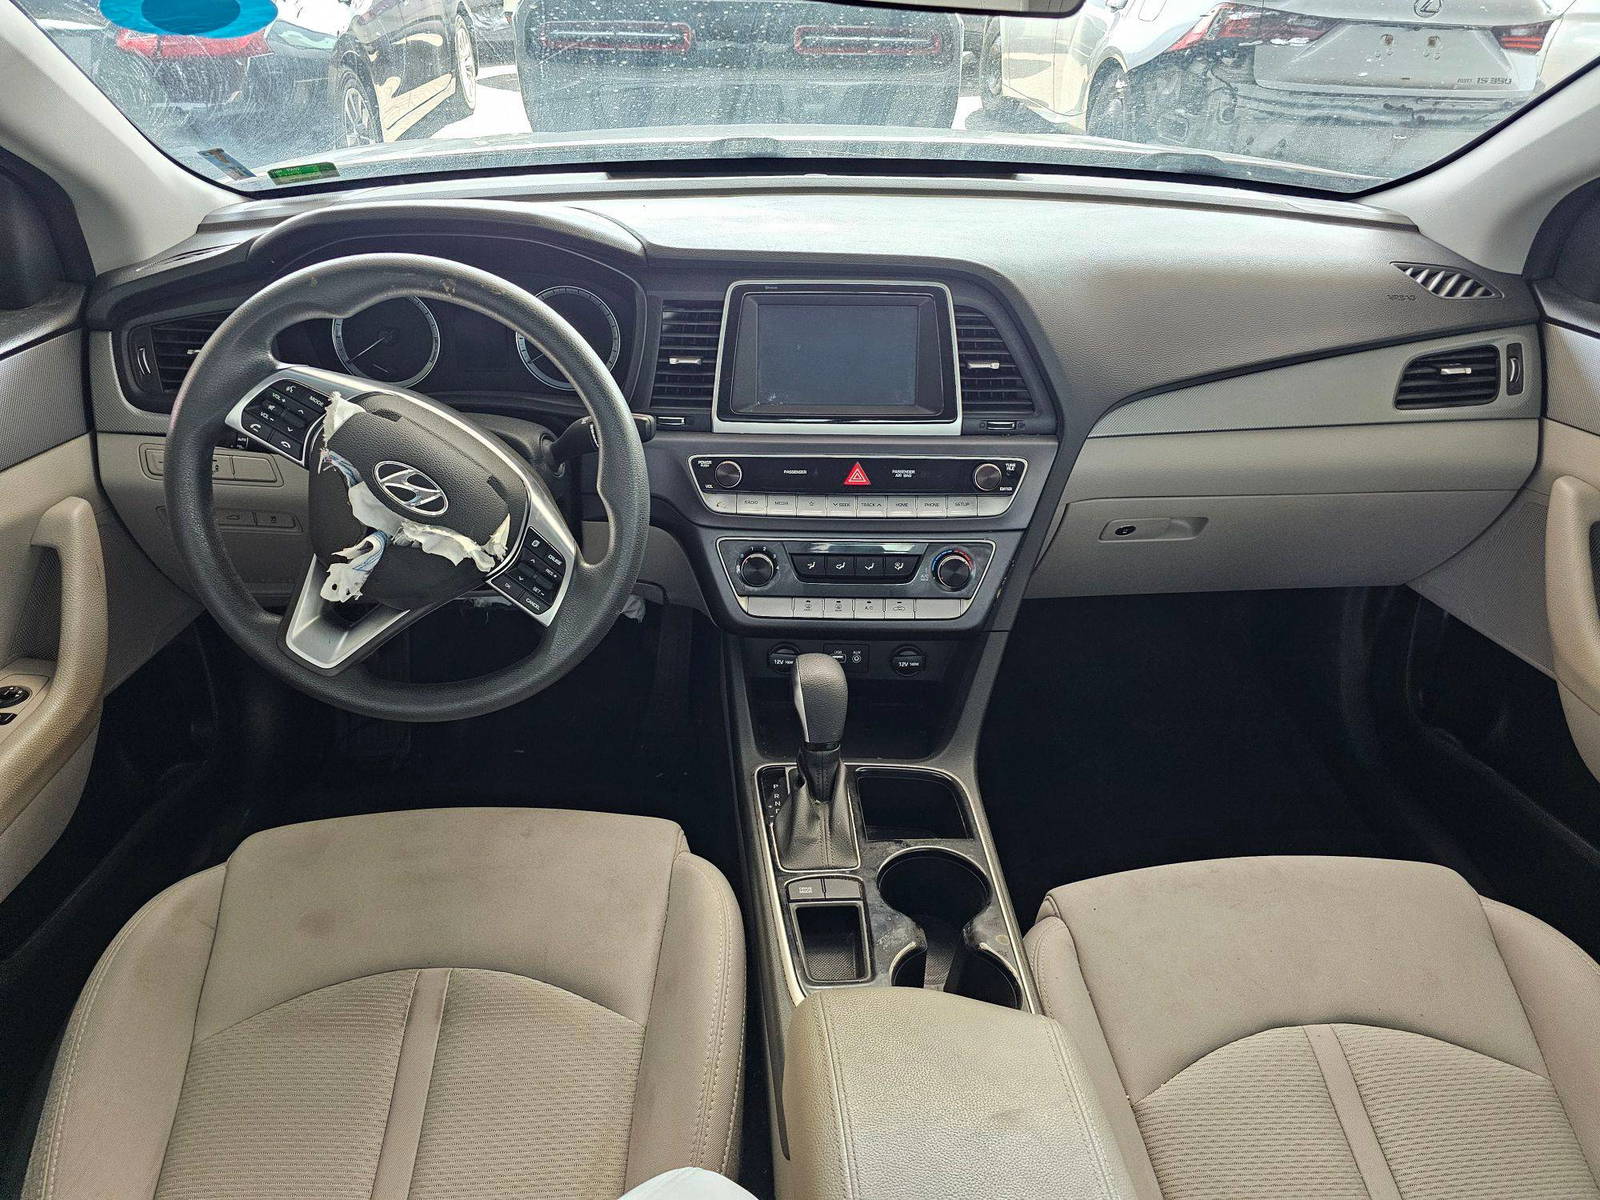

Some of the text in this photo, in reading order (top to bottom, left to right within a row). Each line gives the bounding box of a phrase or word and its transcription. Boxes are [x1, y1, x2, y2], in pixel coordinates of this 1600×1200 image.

[310, 396, 325, 407] MODE
[548, 554, 562, 566] CRUISE
[526, 598, 540, 610] CANCEL
